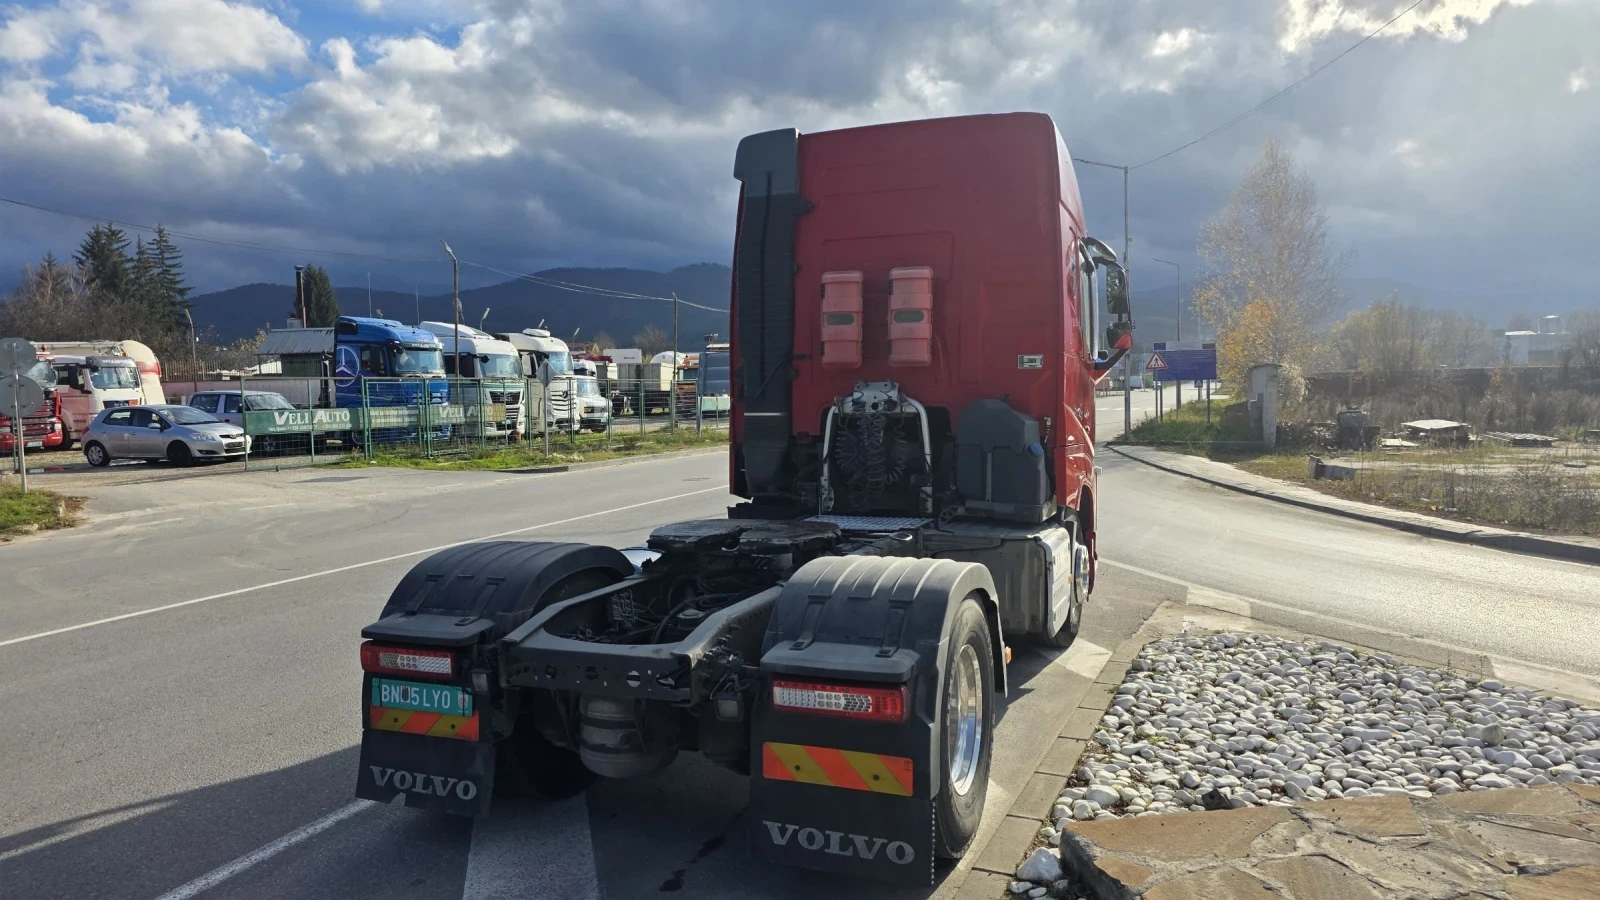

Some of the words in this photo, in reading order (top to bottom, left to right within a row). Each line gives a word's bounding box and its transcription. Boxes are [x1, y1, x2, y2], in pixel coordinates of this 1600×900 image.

[273, 411, 309, 425] VELI
[313, 410, 350, 424] AUTO
[370, 765, 477, 800] VOLVO
[763, 820, 915, 865] VOLVO
